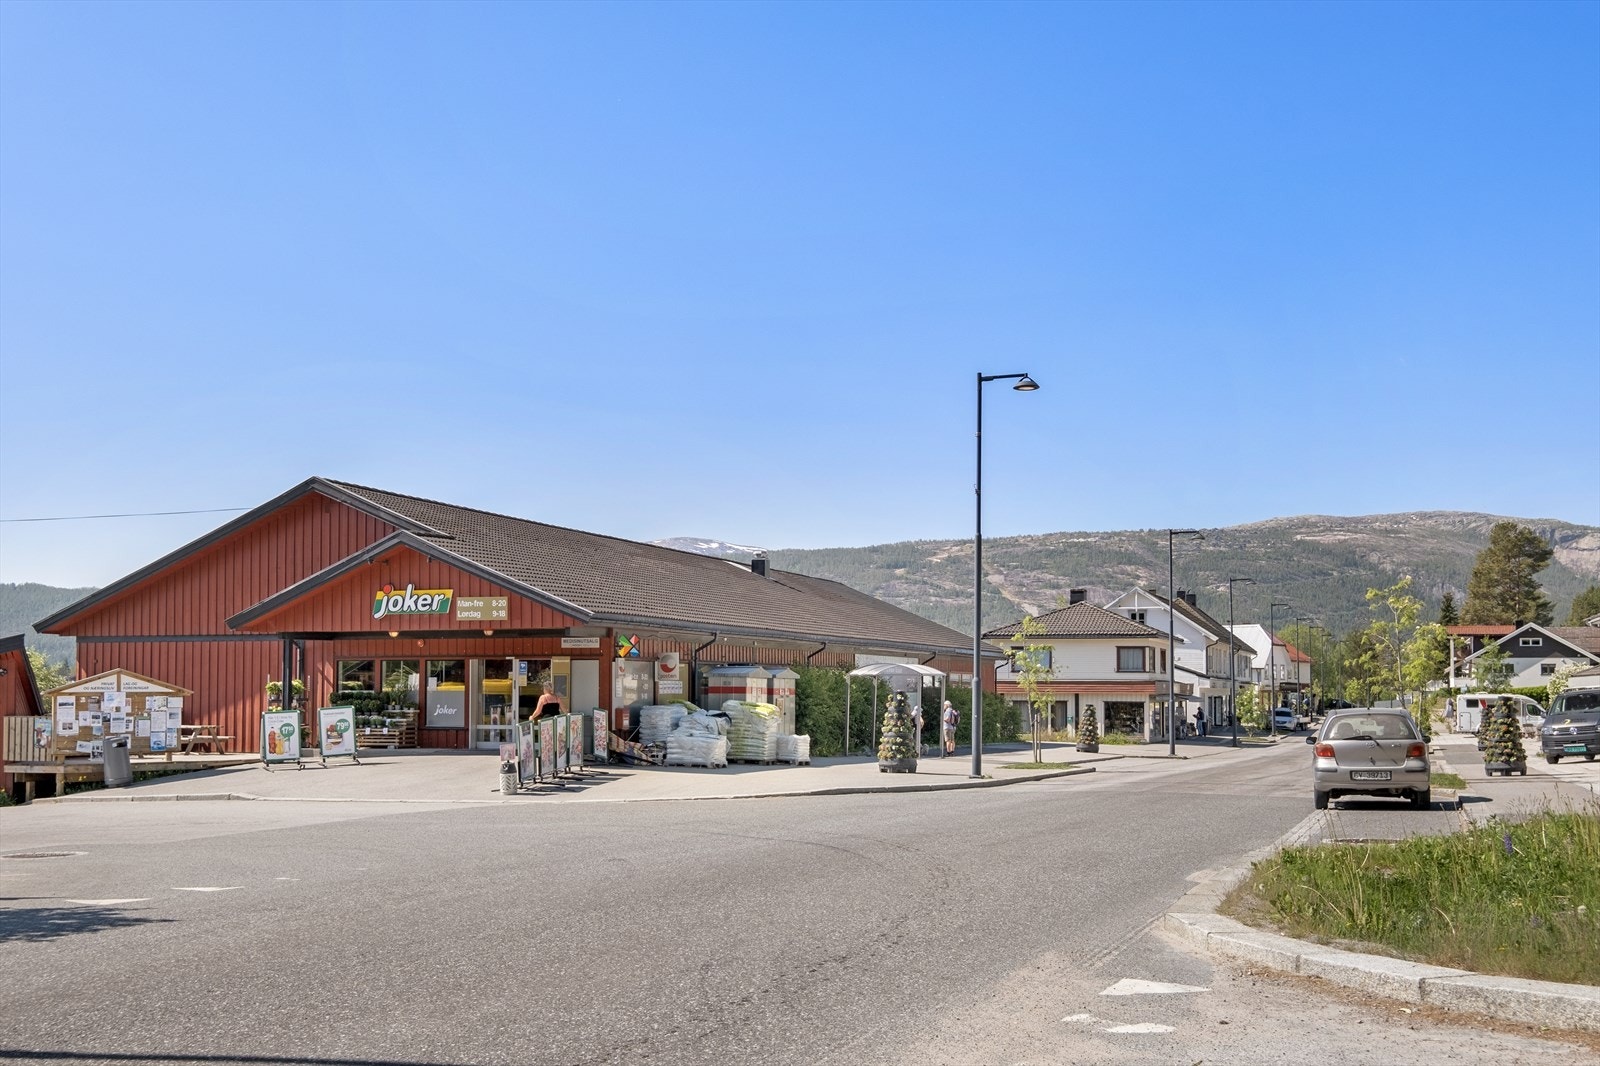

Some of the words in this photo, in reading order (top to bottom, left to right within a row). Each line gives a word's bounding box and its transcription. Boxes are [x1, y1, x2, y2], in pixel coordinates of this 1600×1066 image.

[373, 583, 447, 619] joker
[457, 600, 484, 608] Man-fre
[491, 599, 507, 608] 8-20
[457, 610, 482, 619] Lørdag
[492, 610, 506, 618] 9-18
[433, 704, 457, 716] joker
